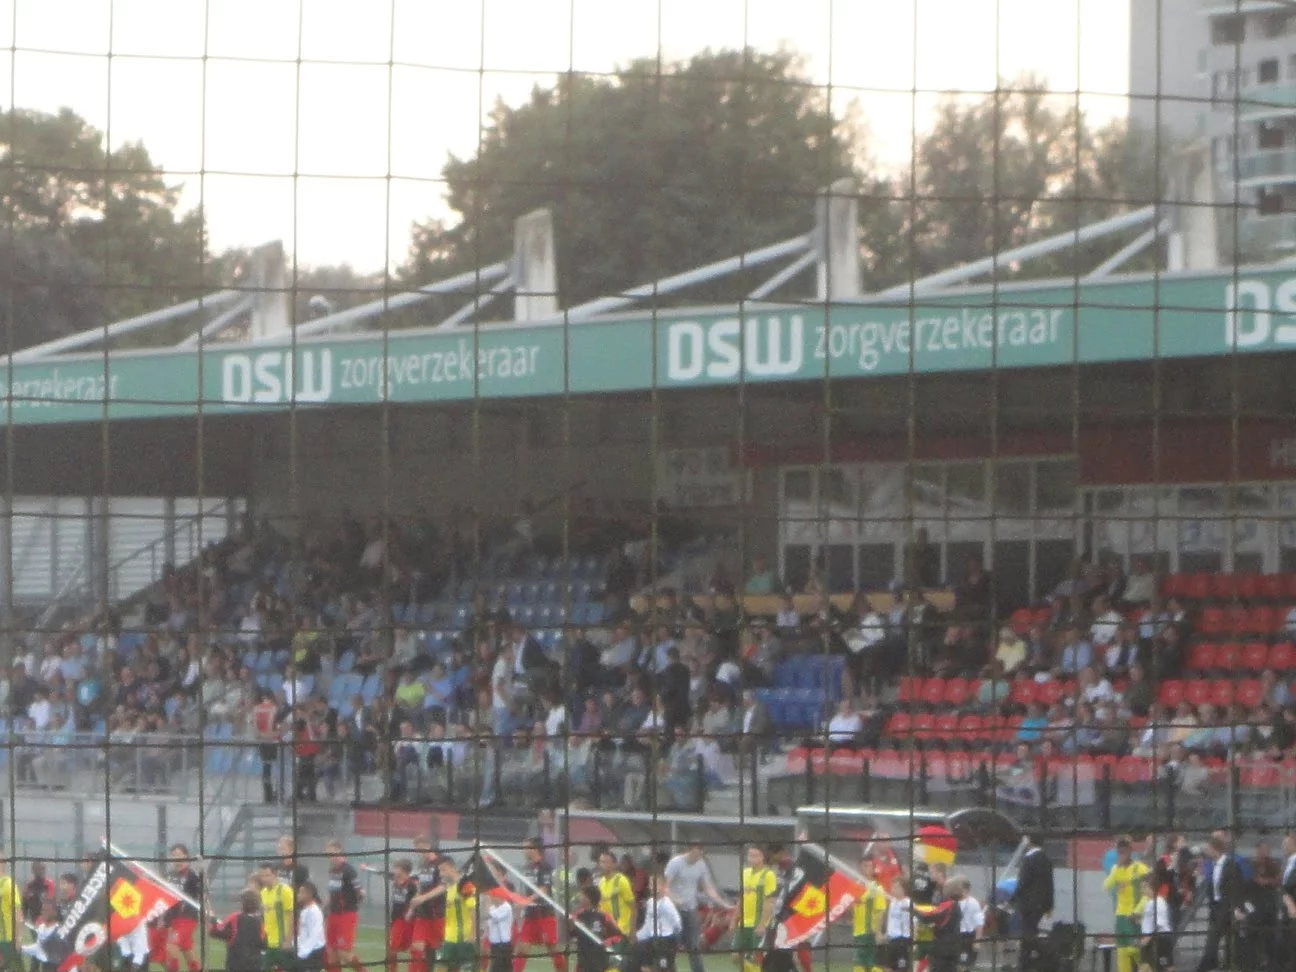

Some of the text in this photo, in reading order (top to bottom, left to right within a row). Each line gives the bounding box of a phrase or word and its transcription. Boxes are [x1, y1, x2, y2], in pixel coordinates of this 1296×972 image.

[223, 339, 540, 402] DSW zorgverzekeraar
[668, 309, 1063, 380] DSW zorgverzekeraar
